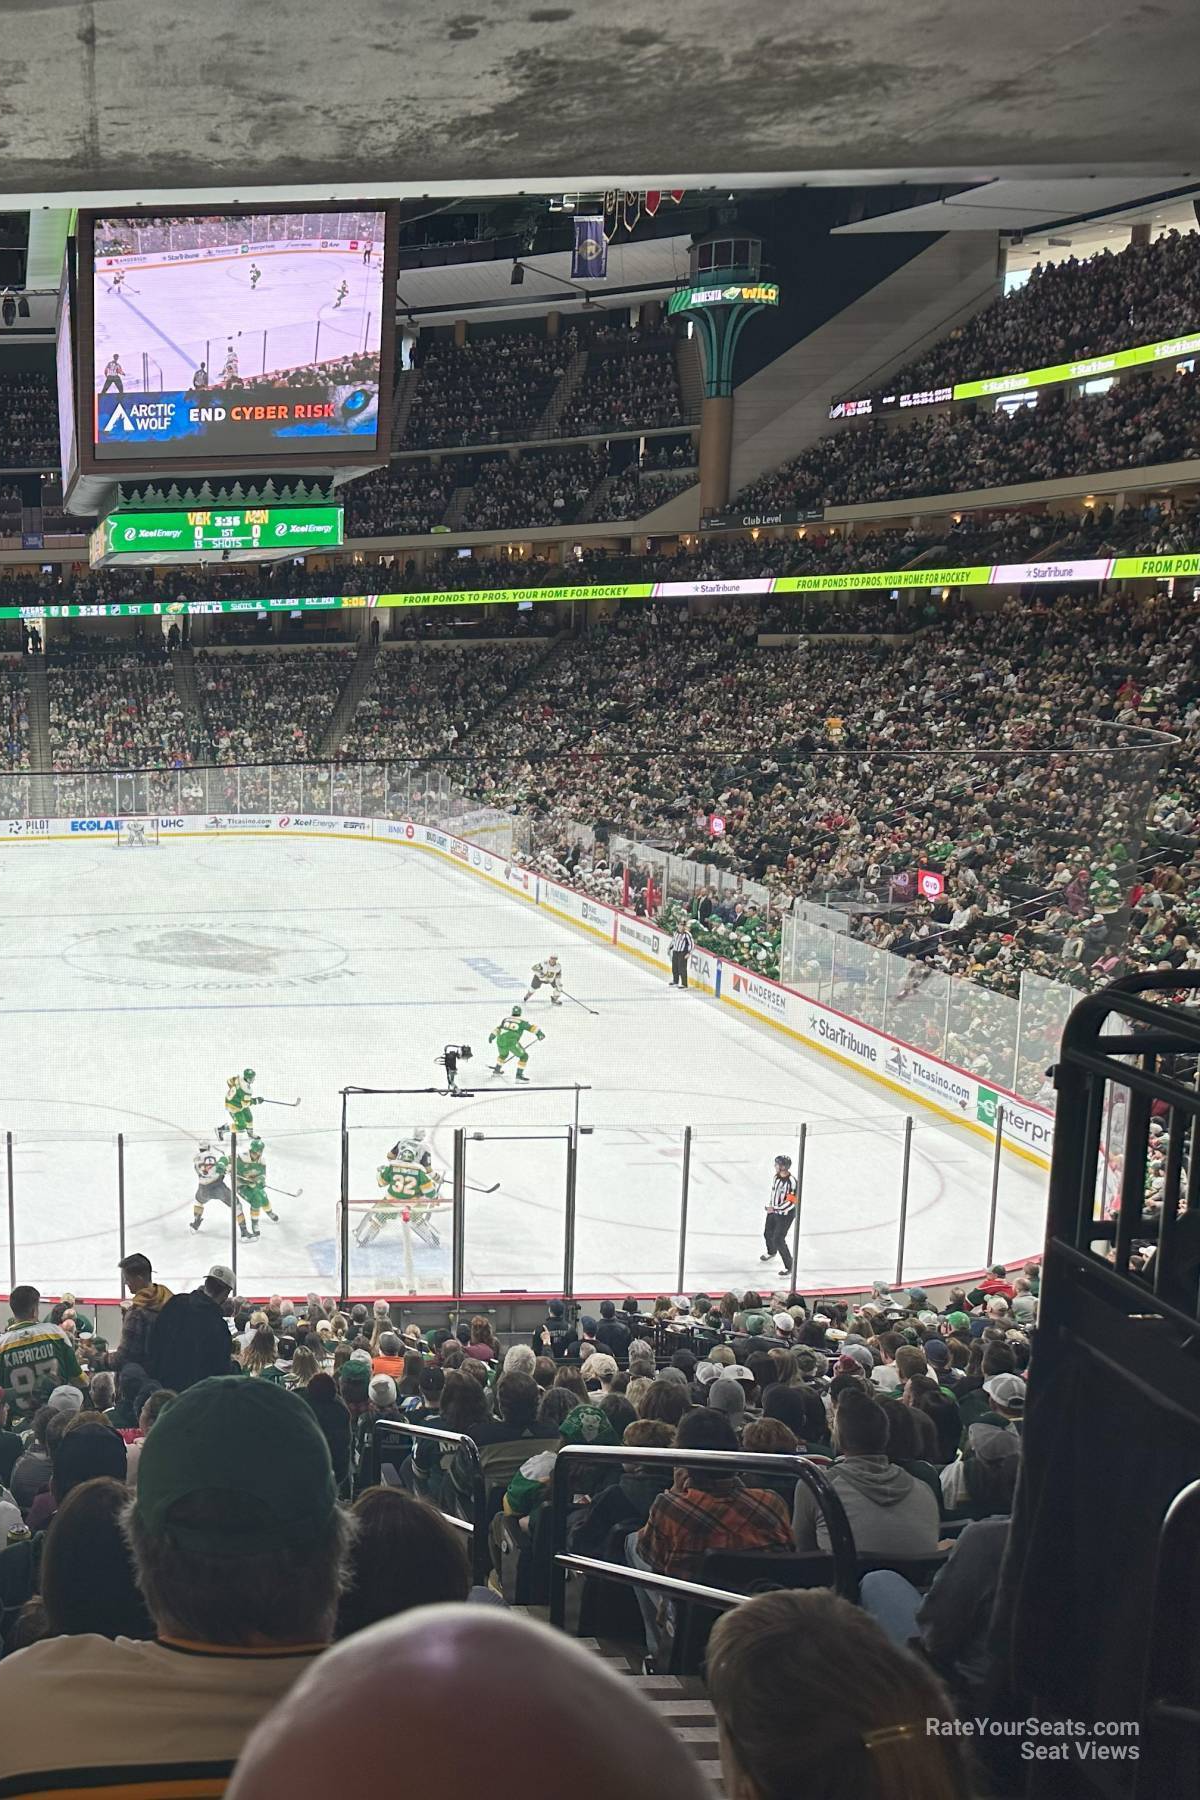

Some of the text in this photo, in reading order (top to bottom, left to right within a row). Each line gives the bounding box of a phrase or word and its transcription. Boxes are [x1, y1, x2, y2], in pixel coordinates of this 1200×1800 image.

[741, 287, 777, 300] WILD
[131, 403, 176, 417] ARCTIC
[189, 403, 335, 422] END CYBER RISK
[136, 418, 171, 431] WOLF
[742, 514, 782, 526] Club Level
[138, 523, 333, 539] Xcel Energy 0 1ST 0 Xcel Energy
[212, 539, 242, 548] SHOTS
[1141, 558, 1200, 573] FROM PON
[1033, 567, 1073, 578] StarTribune
[796, 579, 820, 590] FROM
[822, 578, 848, 588] PONDS
[850, 578, 860, 587] TO
[884, 576, 903, 586] YOUR
[903, 575, 926, 585] HOME
[925, 574, 939, 583] FOR
[940, 571, 971, 583] HOCKEY
[403, 596, 430, 604] FROM
[468, 594, 480, 602] TO
[512, 591, 538, 600] YOUR
[541, 590, 568, 599] HOME
[570, 589, 589, 597] FOR
[591, 587, 628, 596] HOCKEY
[700, 585, 740, 593] StarTribune
[128, 605, 142, 614] 1ST
[153, 603, 161, 614] 0
[187, 604, 223, 614] WILD
[26, 820, 49, 830] PILOT
[70, 820, 123, 831] ECOLAB
[161, 819, 184, 828] UHC
[312, 821, 337, 829] Energy
[688, 953, 711, 979] RIA
[748, 981, 786, 1009] ANDERSEN
[819, 1018, 877, 1062] StarTribune
[392, 1174, 417, 1196] 32
